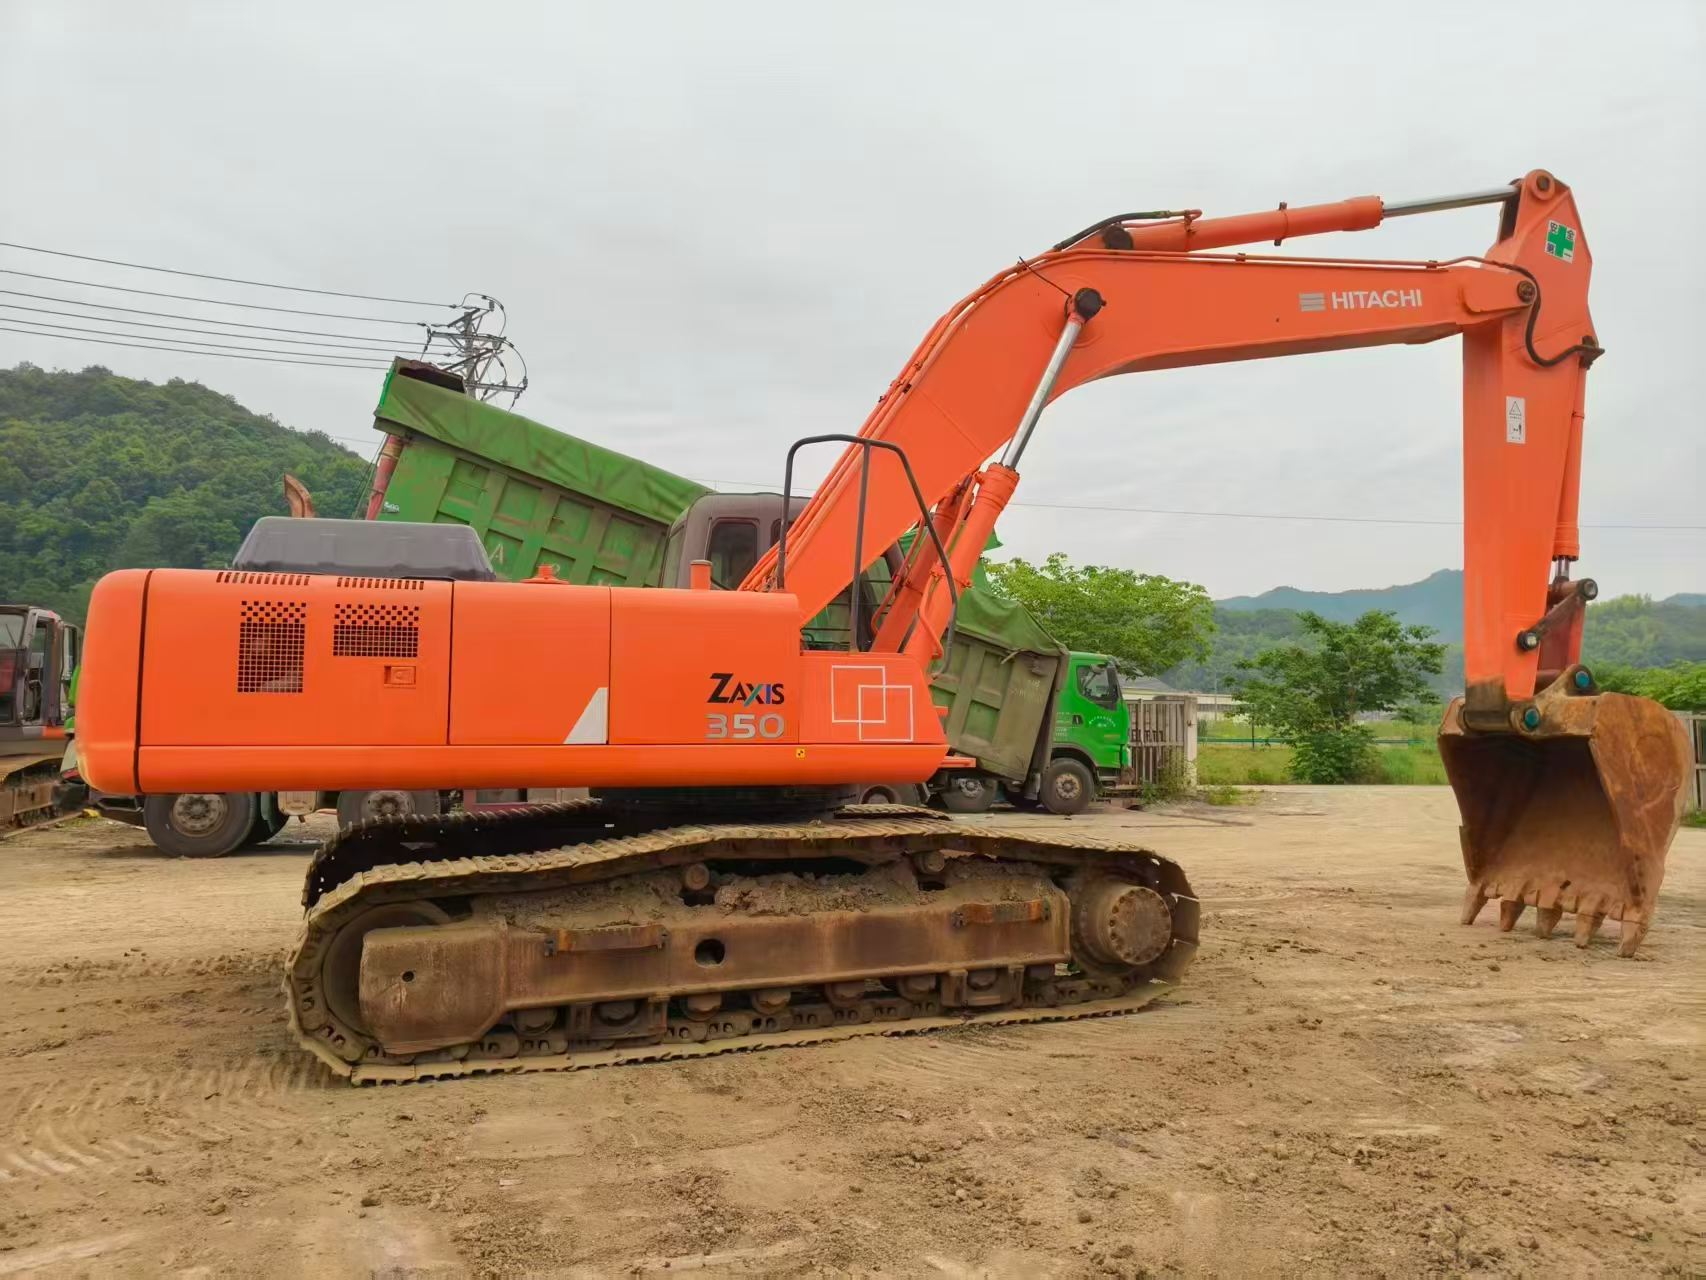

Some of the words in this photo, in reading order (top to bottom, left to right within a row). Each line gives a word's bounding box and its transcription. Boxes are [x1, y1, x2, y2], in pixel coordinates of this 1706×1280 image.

[1331, 289, 1423, 309] HITACHI
[707, 673, 785, 707] ZAXIS
[705, 713, 784, 739] 350
